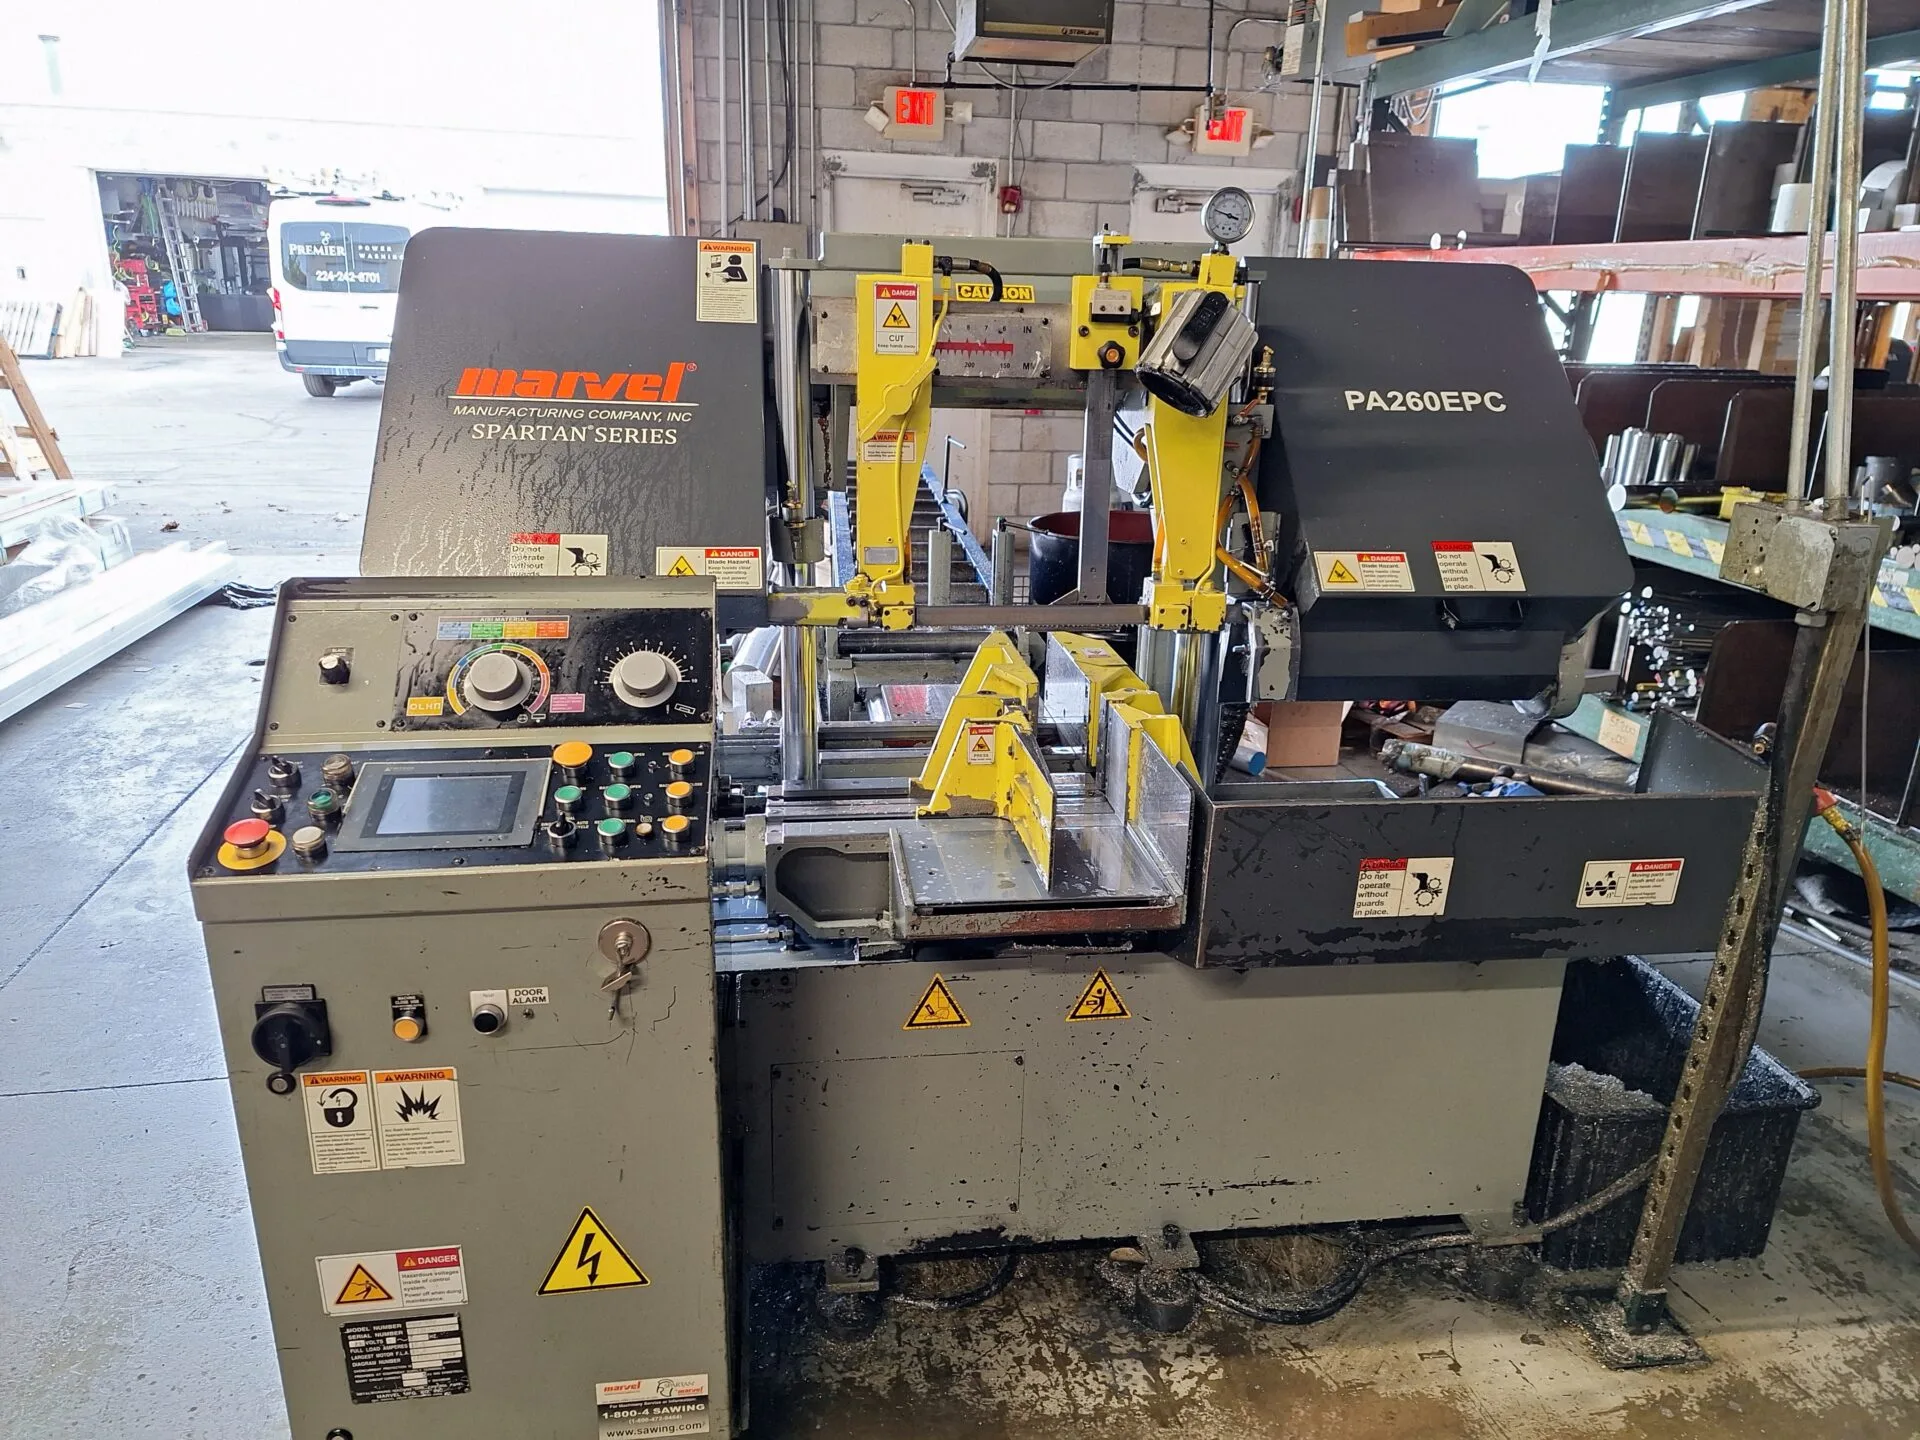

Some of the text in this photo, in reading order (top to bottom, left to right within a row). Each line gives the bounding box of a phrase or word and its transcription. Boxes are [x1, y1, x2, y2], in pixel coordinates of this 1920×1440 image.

[896, 90, 936, 125] EXIT
[288, 244, 346, 256] PREMIER
[960, 286, 1030, 300] CAUION
[1344, 390, 1506, 412] PA260EPC
[453, 405, 692, 422] MANUFACTURING COMPANY, INC
[593, 426, 678, 444] SERIES
[1359, 881, 1391, 890] operate
[1356, 899, 1384, 908] guards
[320, 1074, 361, 1083] WARNING
[394, 1072, 445, 1081] WARNING
[418, 1254, 458, 1265] DANGER
[604, 1381, 641, 1392] marvel
[602, 1404, 705, 1419] 1-800-4 SAWING
[606, 1422, 702, 1437] www.sawing.com
